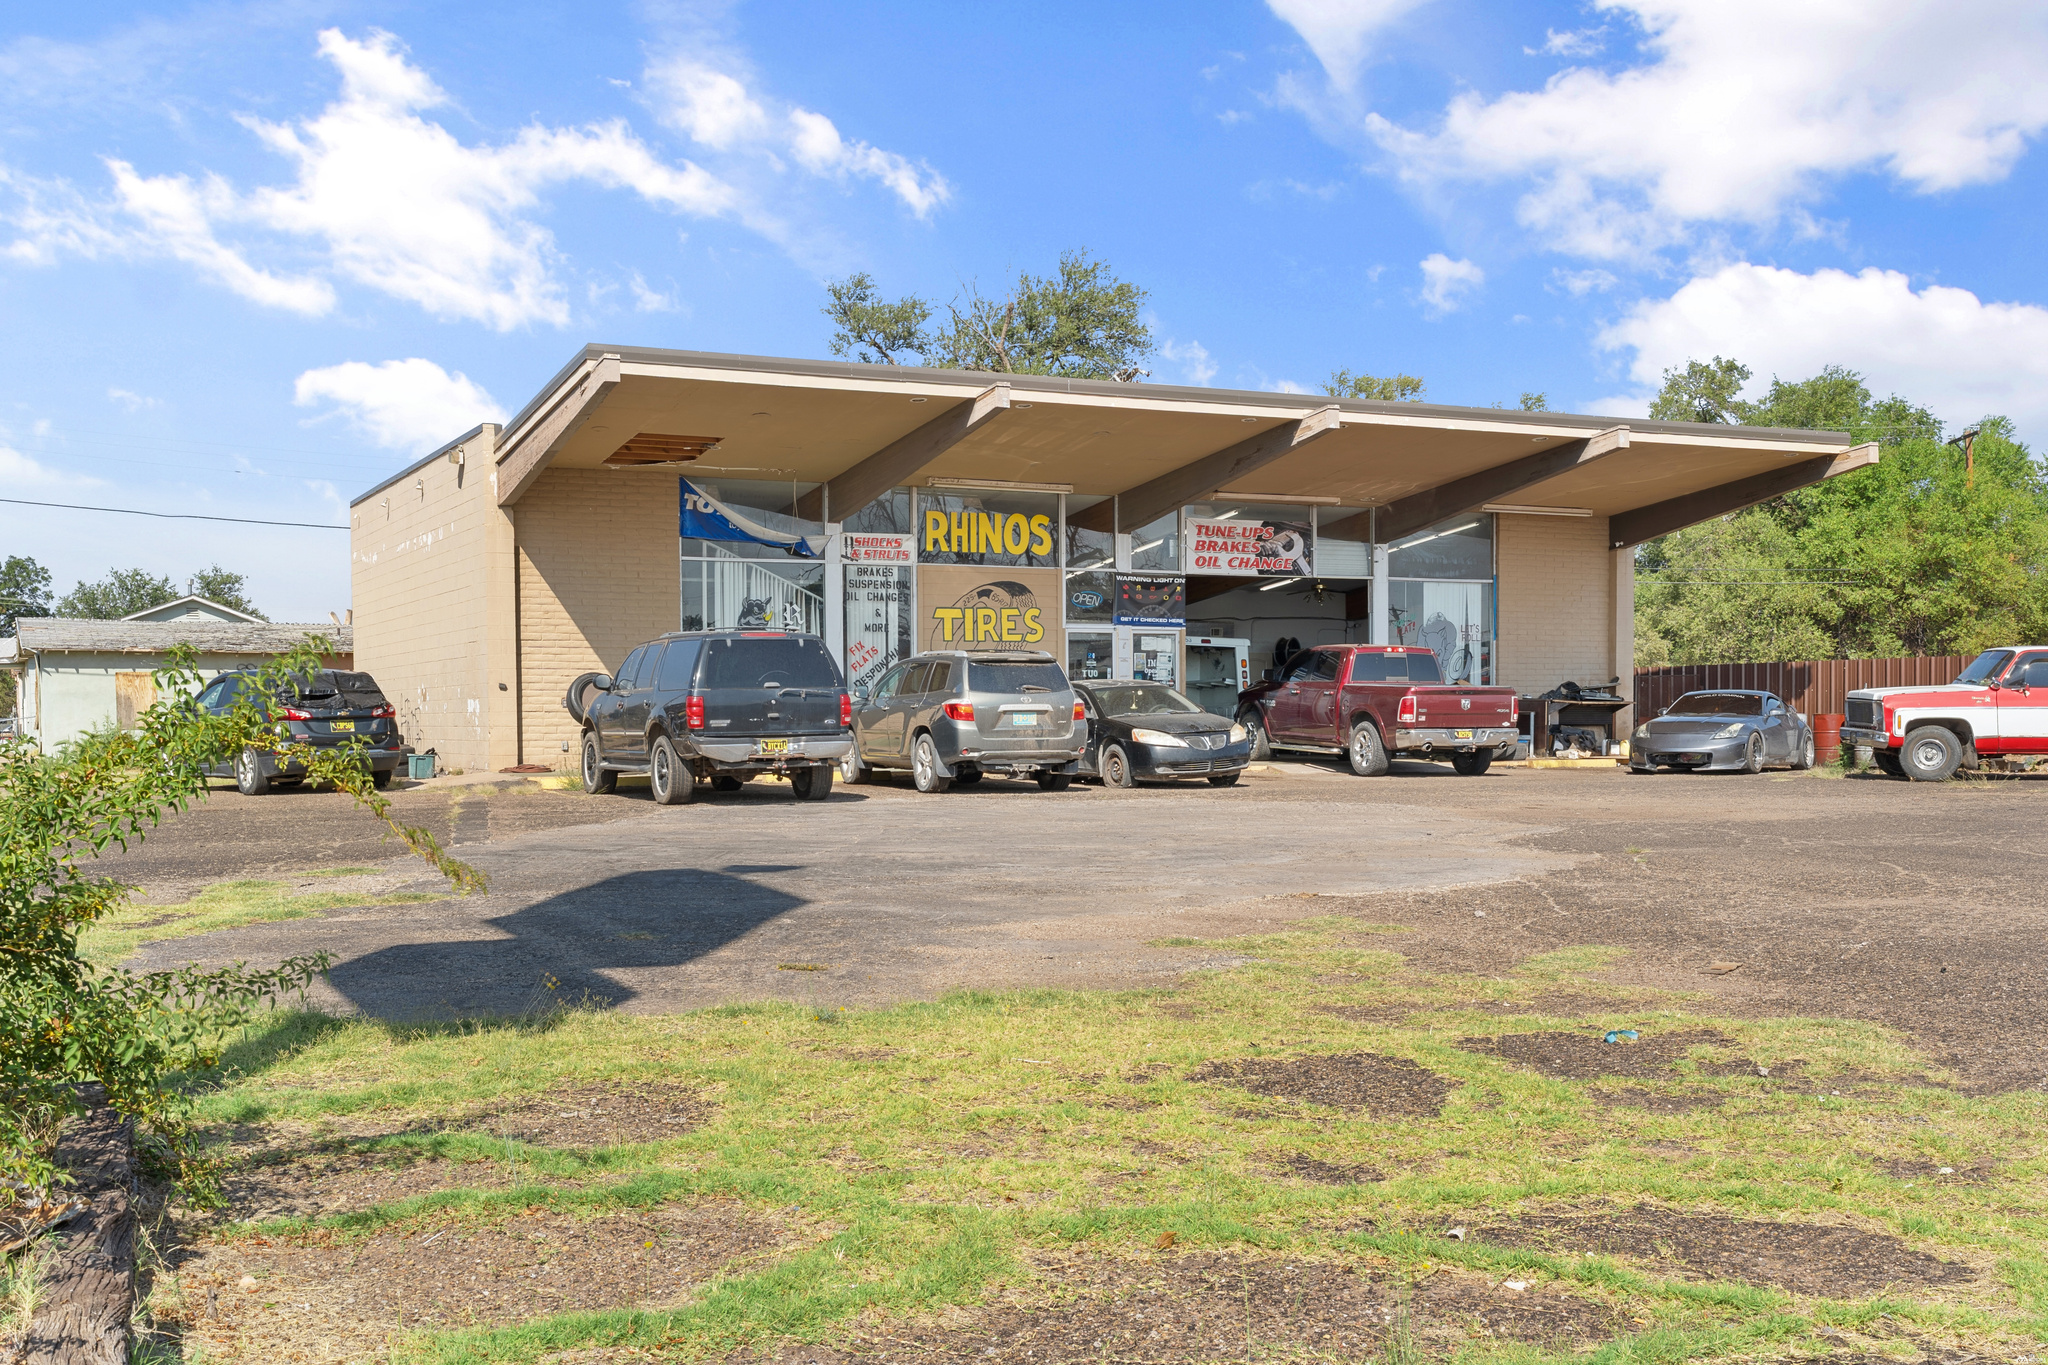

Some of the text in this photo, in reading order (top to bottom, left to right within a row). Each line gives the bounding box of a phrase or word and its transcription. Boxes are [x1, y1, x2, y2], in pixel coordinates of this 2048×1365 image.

[926, 510, 1052, 556] RHINOS
[1196, 525, 1274, 539] TUNE-UPS
[854, 537, 902, 548] SHOCKS
[1195, 540, 1260, 554] BRAKES
[851, 549, 910, 560] & STRUTS
[1195, 556, 1293, 570] OIL CHANGE
[857, 567, 894, 577] BRAKES
[849, 579, 910, 590] SUSPENSION
[1116, 575, 1152, 583] WARNING
[845, 591, 909, 603] OIL CHANGES
[1073, 592, 1101, 607] OPEN
[875, 608, 881, 618] &
[864, 623, 890, 633] MORE
[932, 607, 1045, 643] TIRES
[1460, 624, 1480, 633] LET'S
[1462, 634, 1481, 642] ROLL
[849, 640, 866, 656] FIX
[851, 645, 879, 672] FLATS
